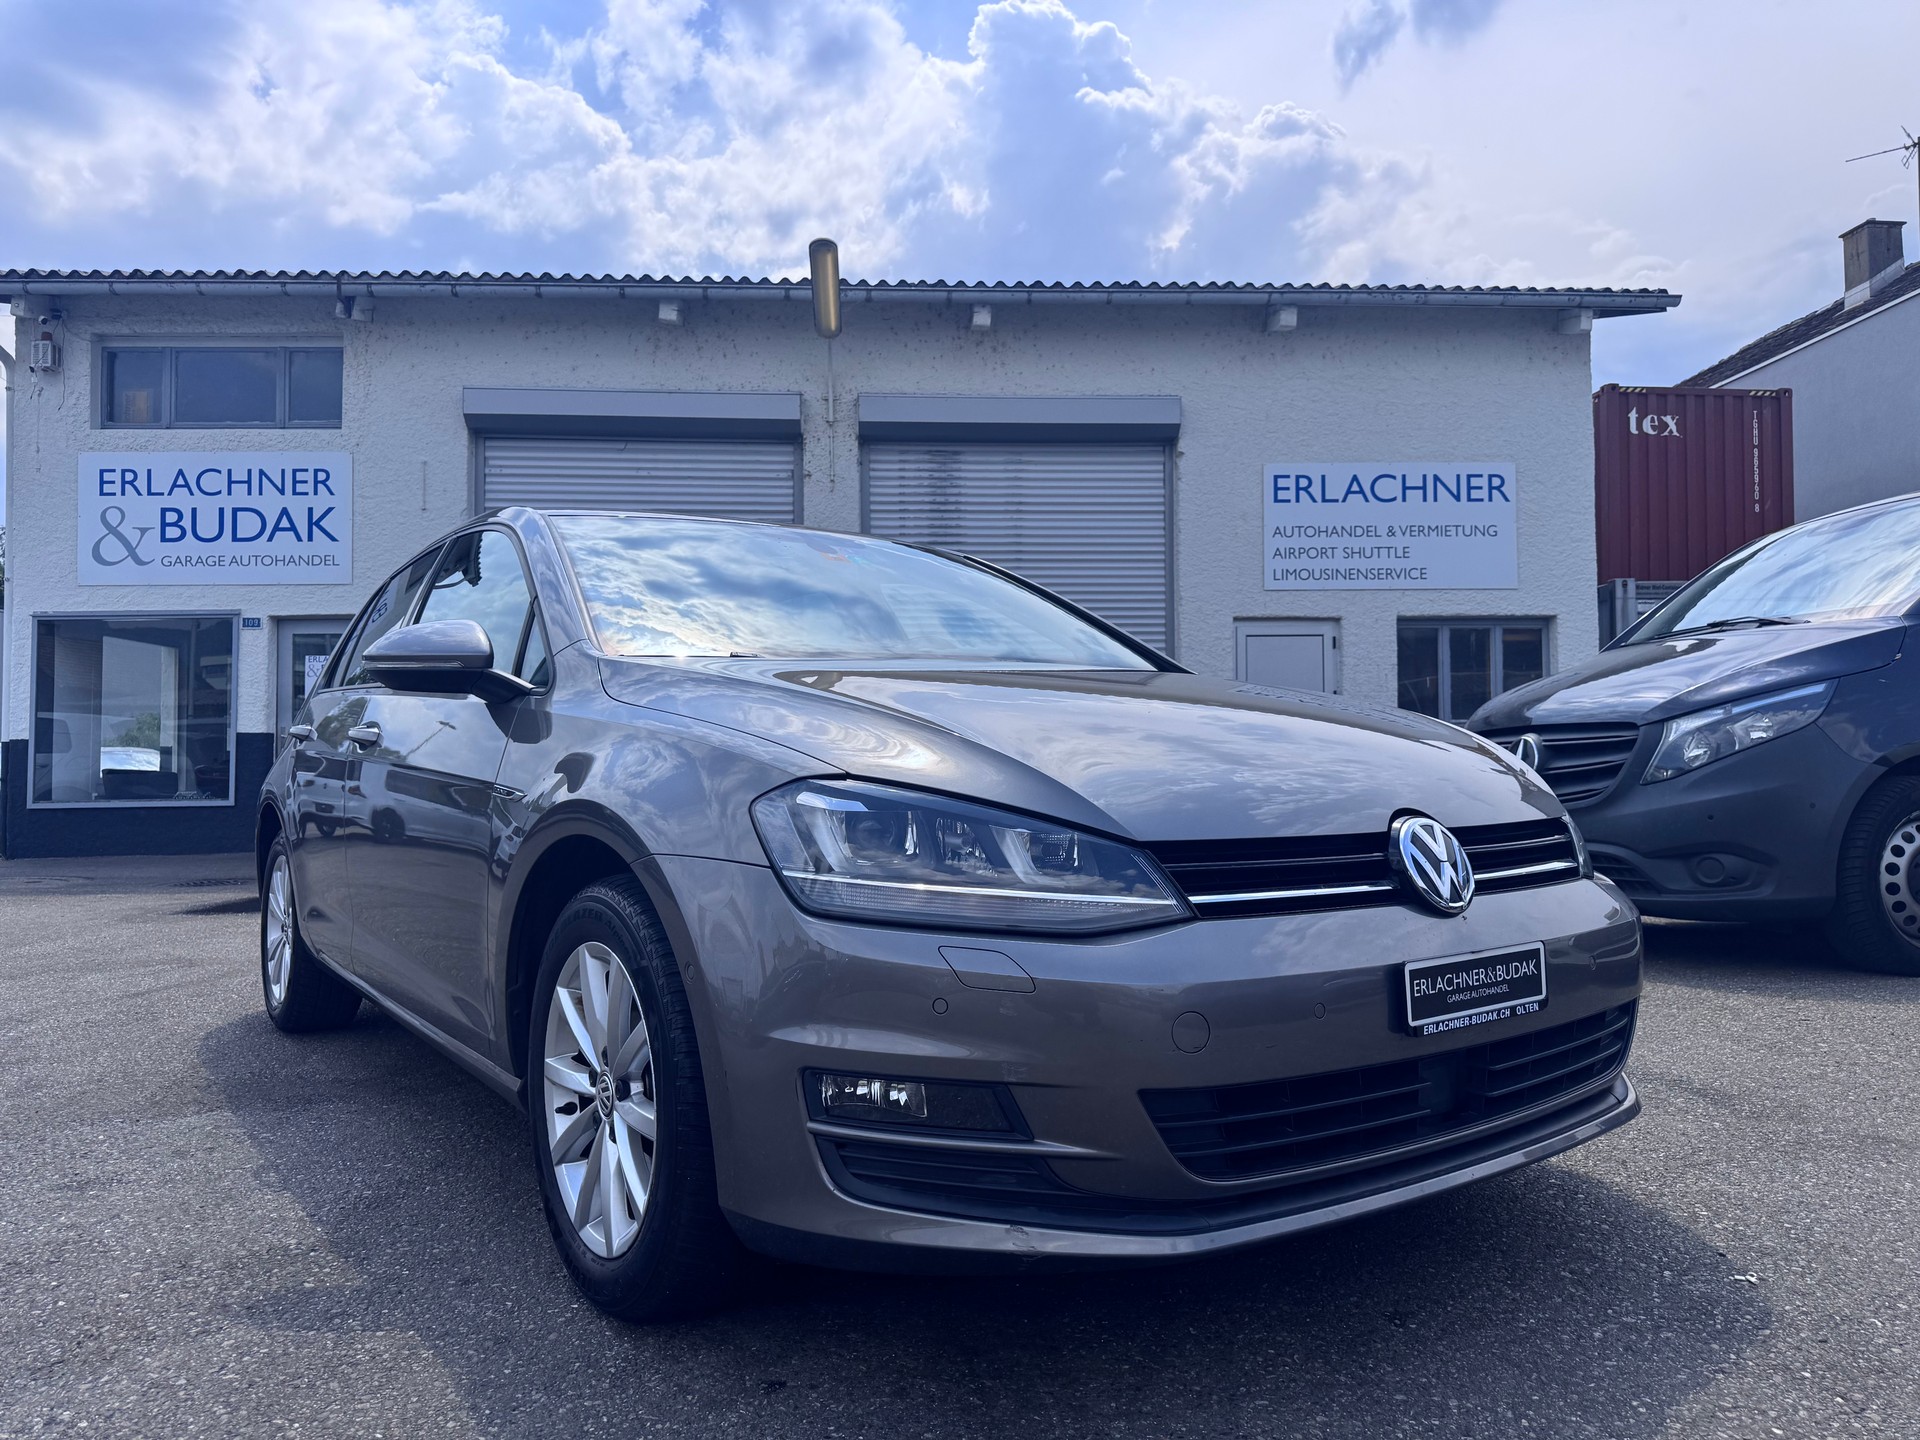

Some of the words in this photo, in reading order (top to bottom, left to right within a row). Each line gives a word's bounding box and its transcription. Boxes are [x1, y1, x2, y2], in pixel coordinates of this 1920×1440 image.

[1627, 406, 1681, 437] tex
[98, 468, 336, 497] ERLACHNER
[1272, 473, 1511, 504] ERLACHNER
[1754, 503, 1760, 513] 8
[91, 505, 156, 567] &
[159, 506, 340, 543] BUDAK
[1272, 525, 1382, 538] AUTOHANDEL
[1386, 525, 1397, 538] &
[1398, 524, 1498, 537] VERMIETUNG
[1272, 547, 1338, 560] AIRPORT
[1342, 546, 1411, 559] SHUTTLE
[160, 555, 226, 568] GARAGE
[228, 554, 340, 567] AUTOHANDEL
[1272, 567, 1428, 581] LIMOUSINENSERVICE
[244, 618, 259, 627] 109
[306, 664, 322, 678] &
[1447, 991, 1471, 1003] GARAGE
[1471, 984, 1510, 998] AUTOHANDEL
[1423, 1008, 1511, 1036] ERLACHNER-BUDAK.CH
[1516, 1002, 1539, 1016] OLTEN
